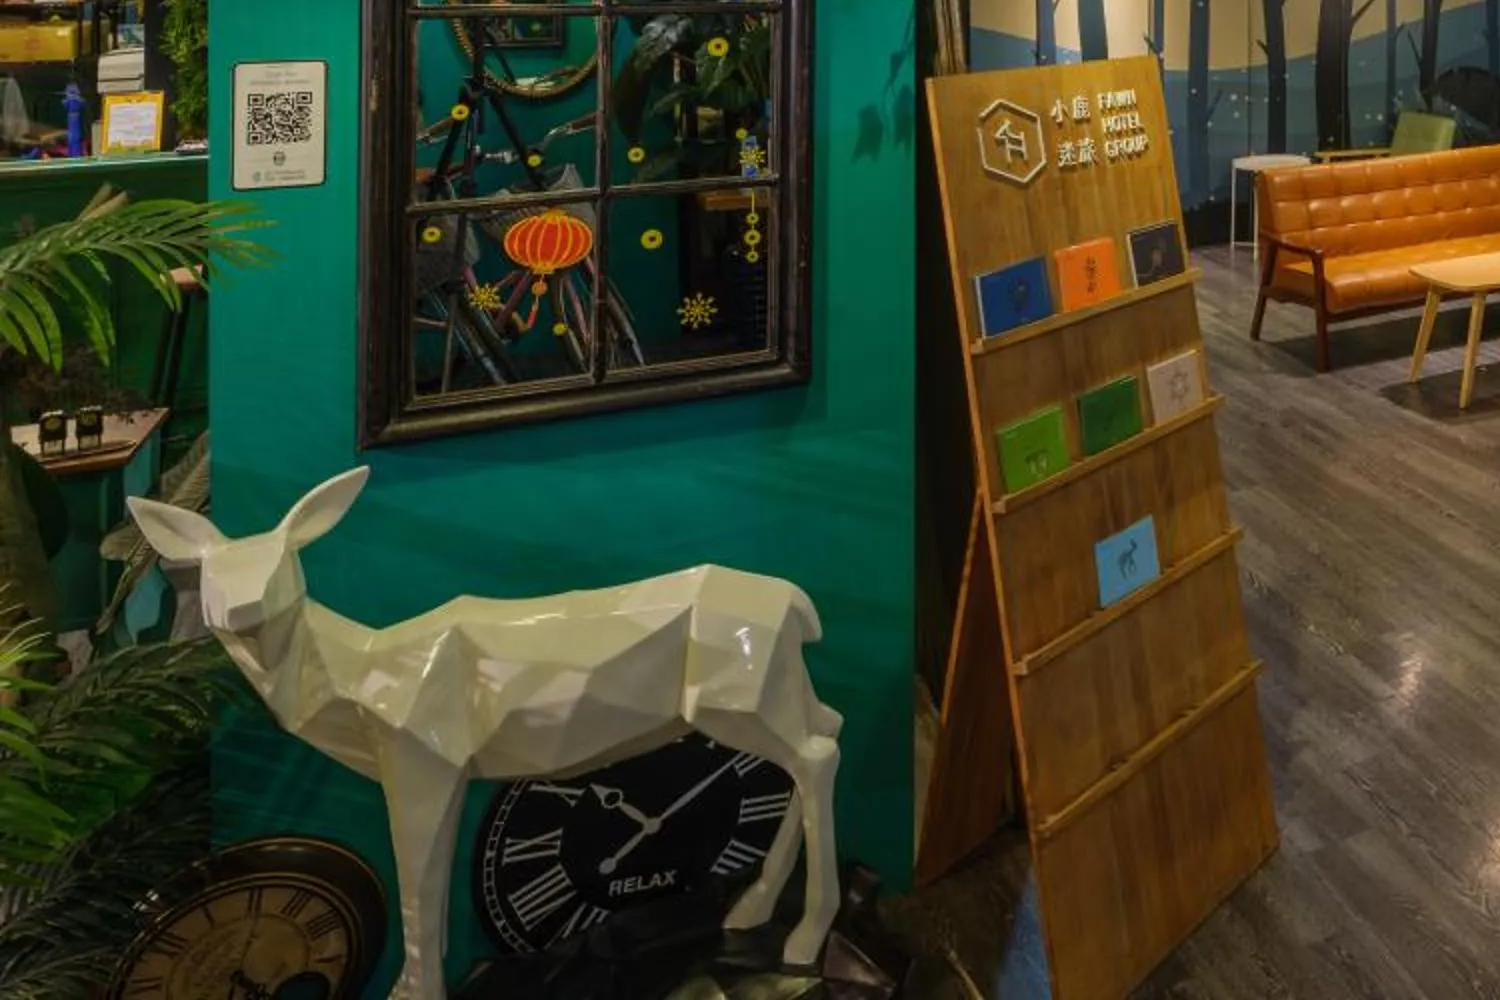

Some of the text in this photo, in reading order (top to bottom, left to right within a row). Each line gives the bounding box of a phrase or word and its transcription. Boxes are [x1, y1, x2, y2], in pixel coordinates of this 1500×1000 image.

[1050, 94, 1091, 124] 小鹿
[1101, 111, 1143, 132] HOTEL
[1104, 135, 1149, 158] GROUP
[609, 869, 676, 897] RELAX
